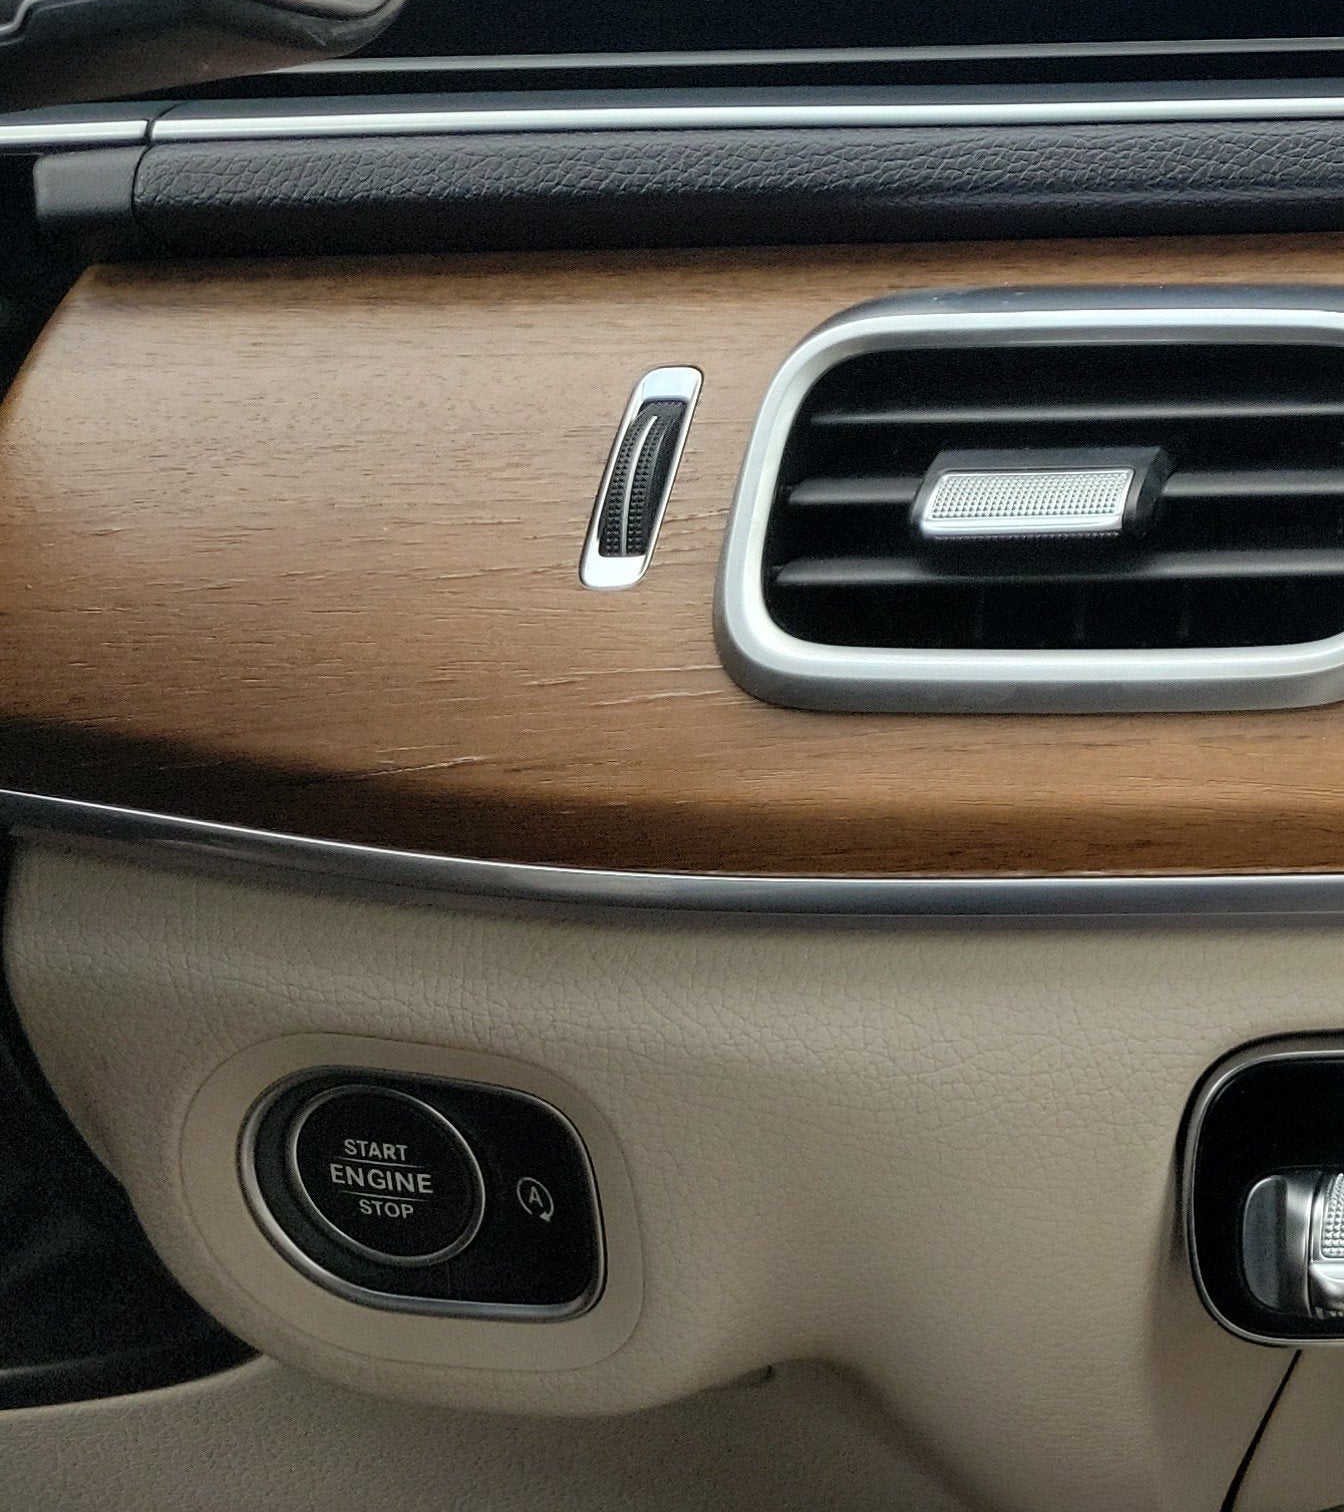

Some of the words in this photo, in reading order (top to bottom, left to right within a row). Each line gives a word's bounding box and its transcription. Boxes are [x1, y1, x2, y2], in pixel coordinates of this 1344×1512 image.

[344, 1138, 408, 1162] START
[330, 1163, 433, 1194] ENGINE
[359, 1198, 414, 1219] STOP
